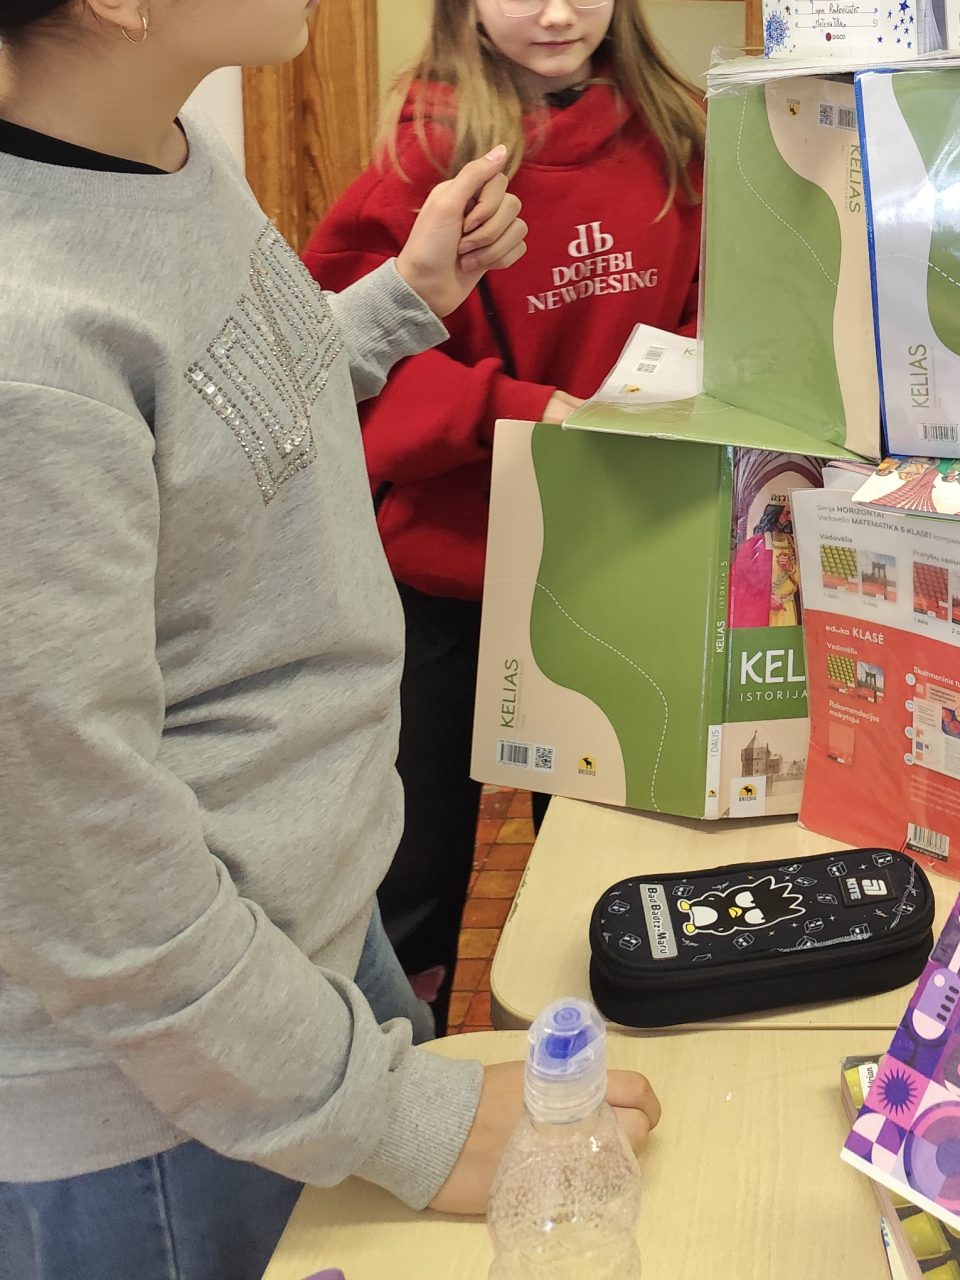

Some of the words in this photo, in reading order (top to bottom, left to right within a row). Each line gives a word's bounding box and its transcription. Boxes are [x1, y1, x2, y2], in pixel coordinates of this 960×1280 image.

[849, 144, 862, 213] KELIAS
[552, 251, 634, 286] DOFFBI
[526, 268, 658, 313] NEWDESING
[909, 344, 930, 408] KELIAS
[820, 533, 852, 543] Vadovėlis
[852, 519, 898, 532] MATEMATIKA
[907, 528, 932, 539] KLASEI
[716, 620, 726, 653] KELIAS
[852, 627, 884, 644] KLASĖ
[826, 641, 858, 655] Vadovėlis
[741, 649, 805, 684] KEL
[913, 666, 954, 685] Skaitmeninis
[500, 659, 518, 728] KELIAS
[740, 690, 808, 702] ISTORIJA
[829, 700, 880, 723] Rekomendacijos
[711, 729, 719, 752] DALIS
[648, 888, 658, 902] Bad
[846, 878, 861, 900] KITE
